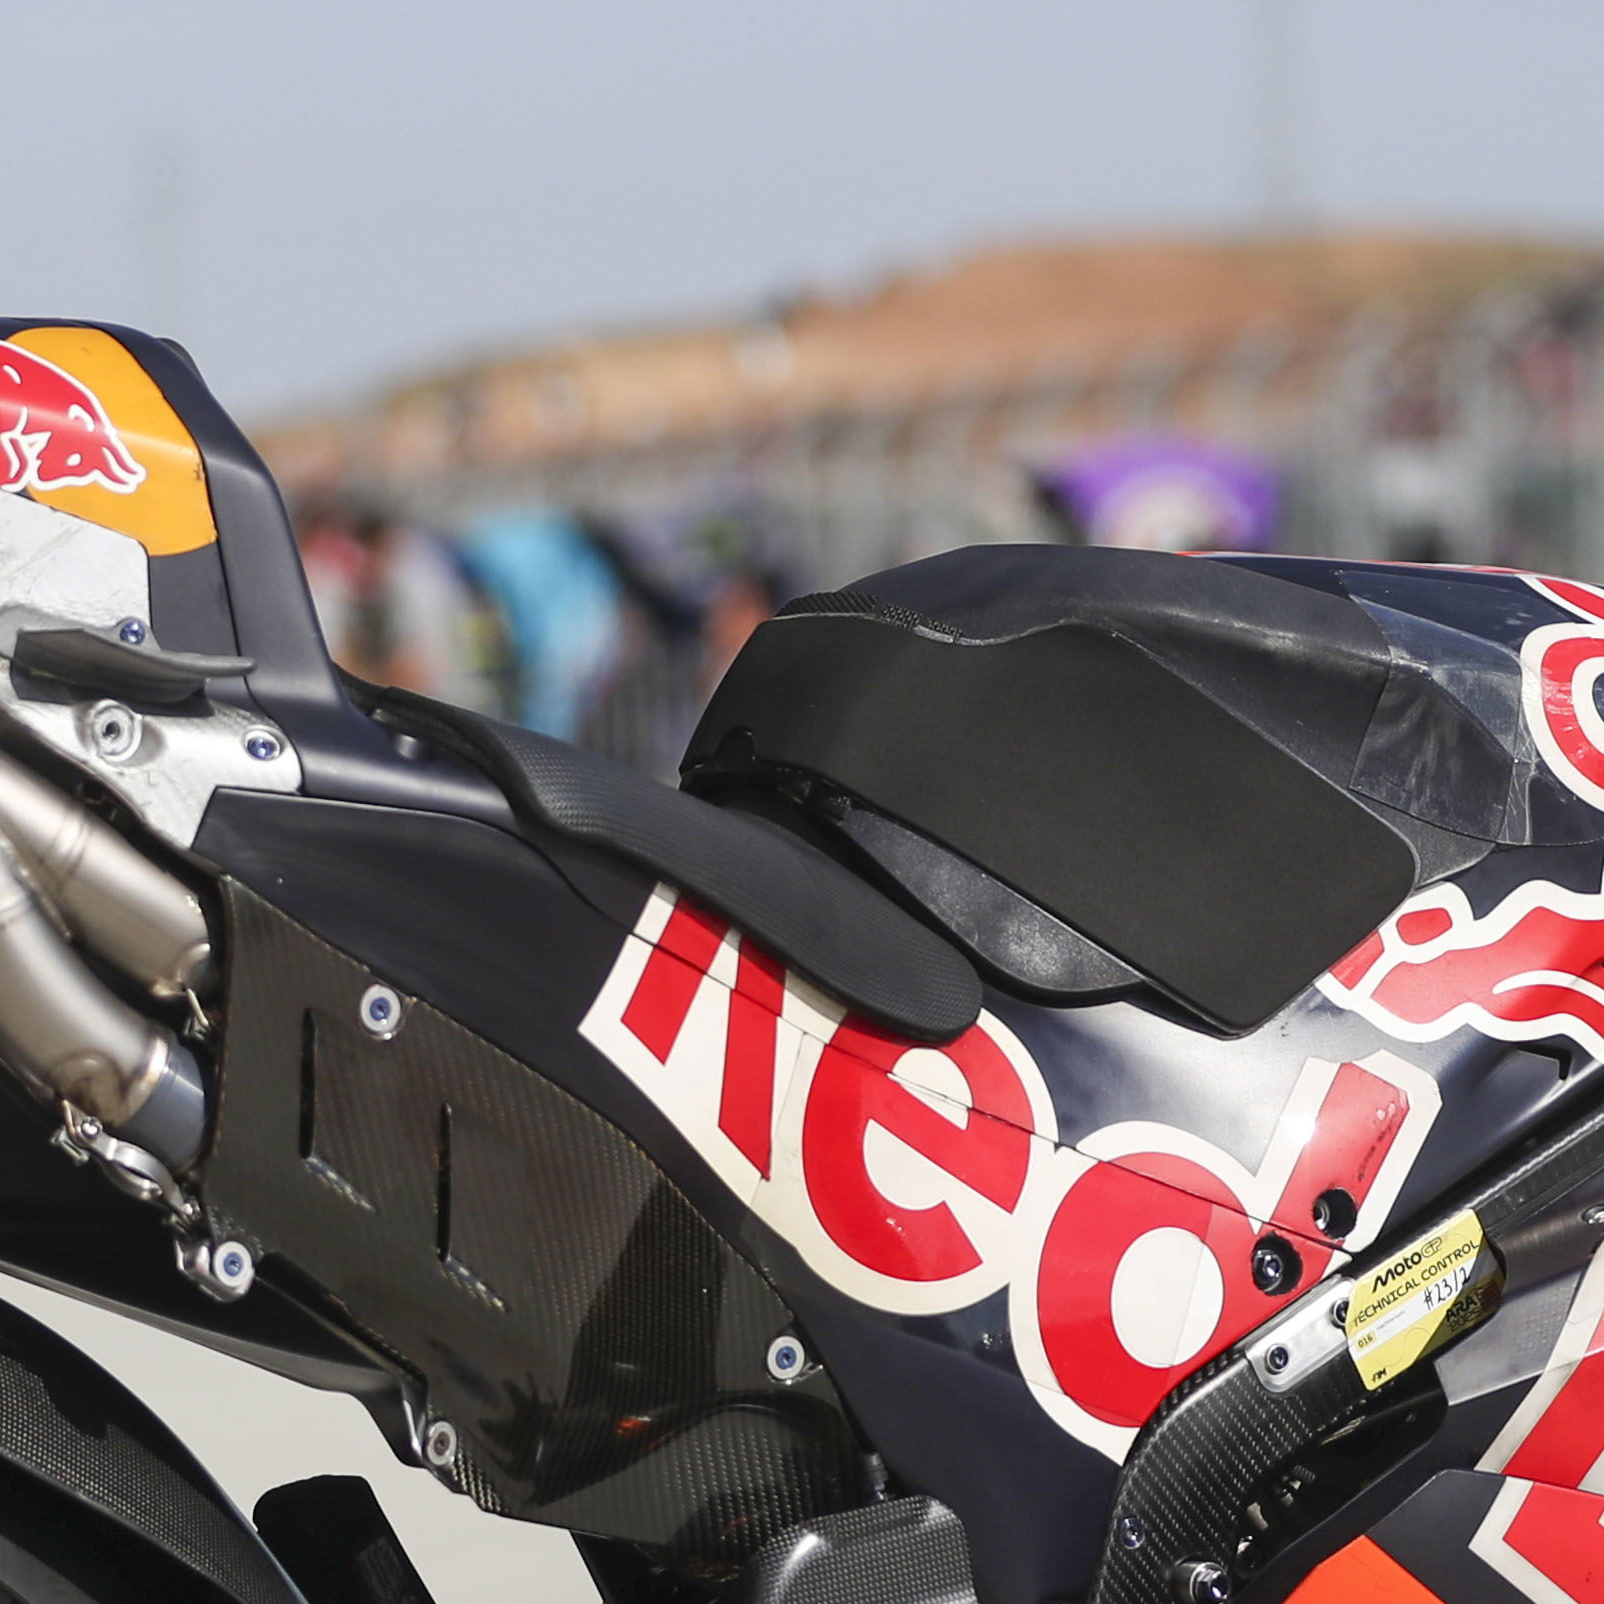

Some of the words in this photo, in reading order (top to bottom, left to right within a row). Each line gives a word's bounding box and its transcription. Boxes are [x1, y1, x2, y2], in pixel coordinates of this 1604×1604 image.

[1353, 1278, 1421, 1327] TECHNICAL
[1420, 1240, 1480, 1283] CONTROL
[1371, 1236, 1443, 1293] MotoGP
